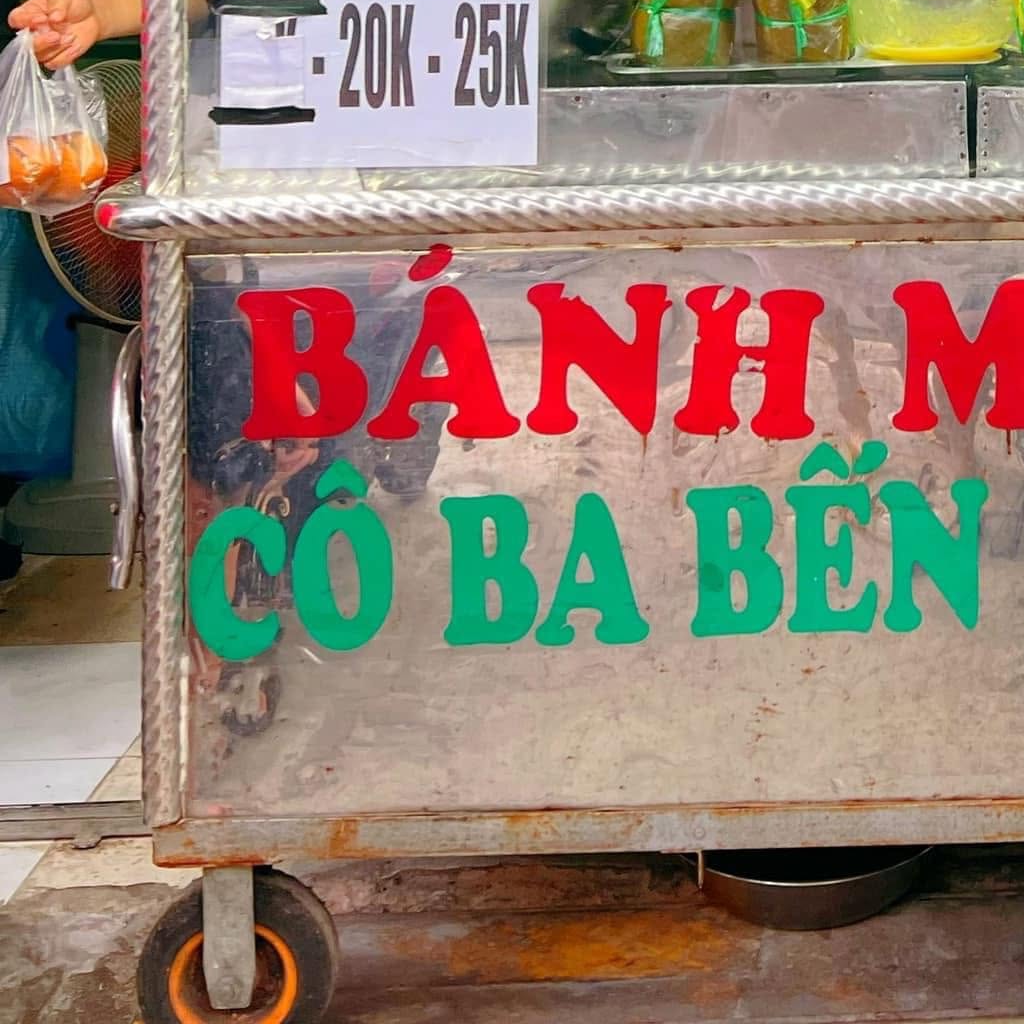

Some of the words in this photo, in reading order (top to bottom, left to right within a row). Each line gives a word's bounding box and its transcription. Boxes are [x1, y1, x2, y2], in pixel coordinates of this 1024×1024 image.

[338, 2, 416, 108] 20K
[453, 1, 530, 107] 25K
[236, 243, 824, 441] BÁNH
[188, 458, 394, 662] CÔ
[439, 492, 650, 647] BA
[685, 439, 989, 636] BẾN
